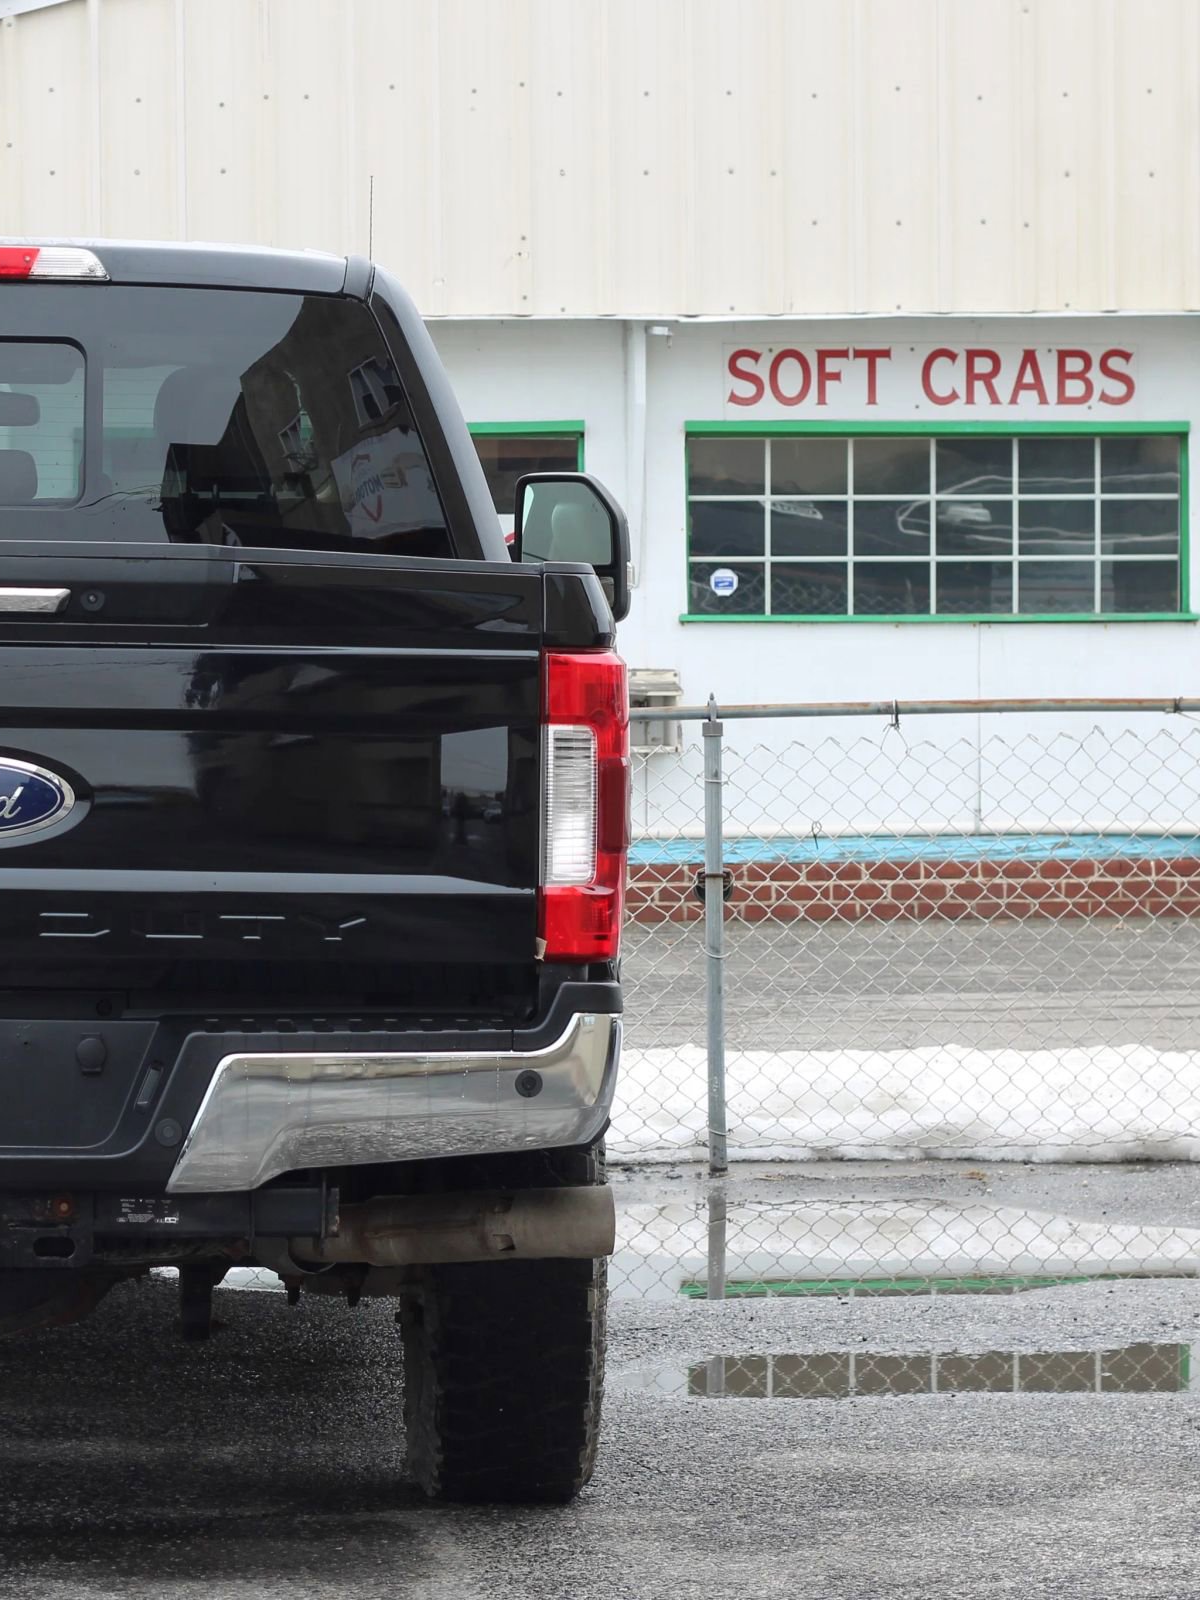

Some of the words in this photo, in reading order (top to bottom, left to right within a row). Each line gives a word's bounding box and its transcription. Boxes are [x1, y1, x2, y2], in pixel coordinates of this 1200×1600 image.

[727, 346, 891, 406] SOFT
[921, 347, 1136, 406] CRABS
[38, 907, 368, 941] DUTY
